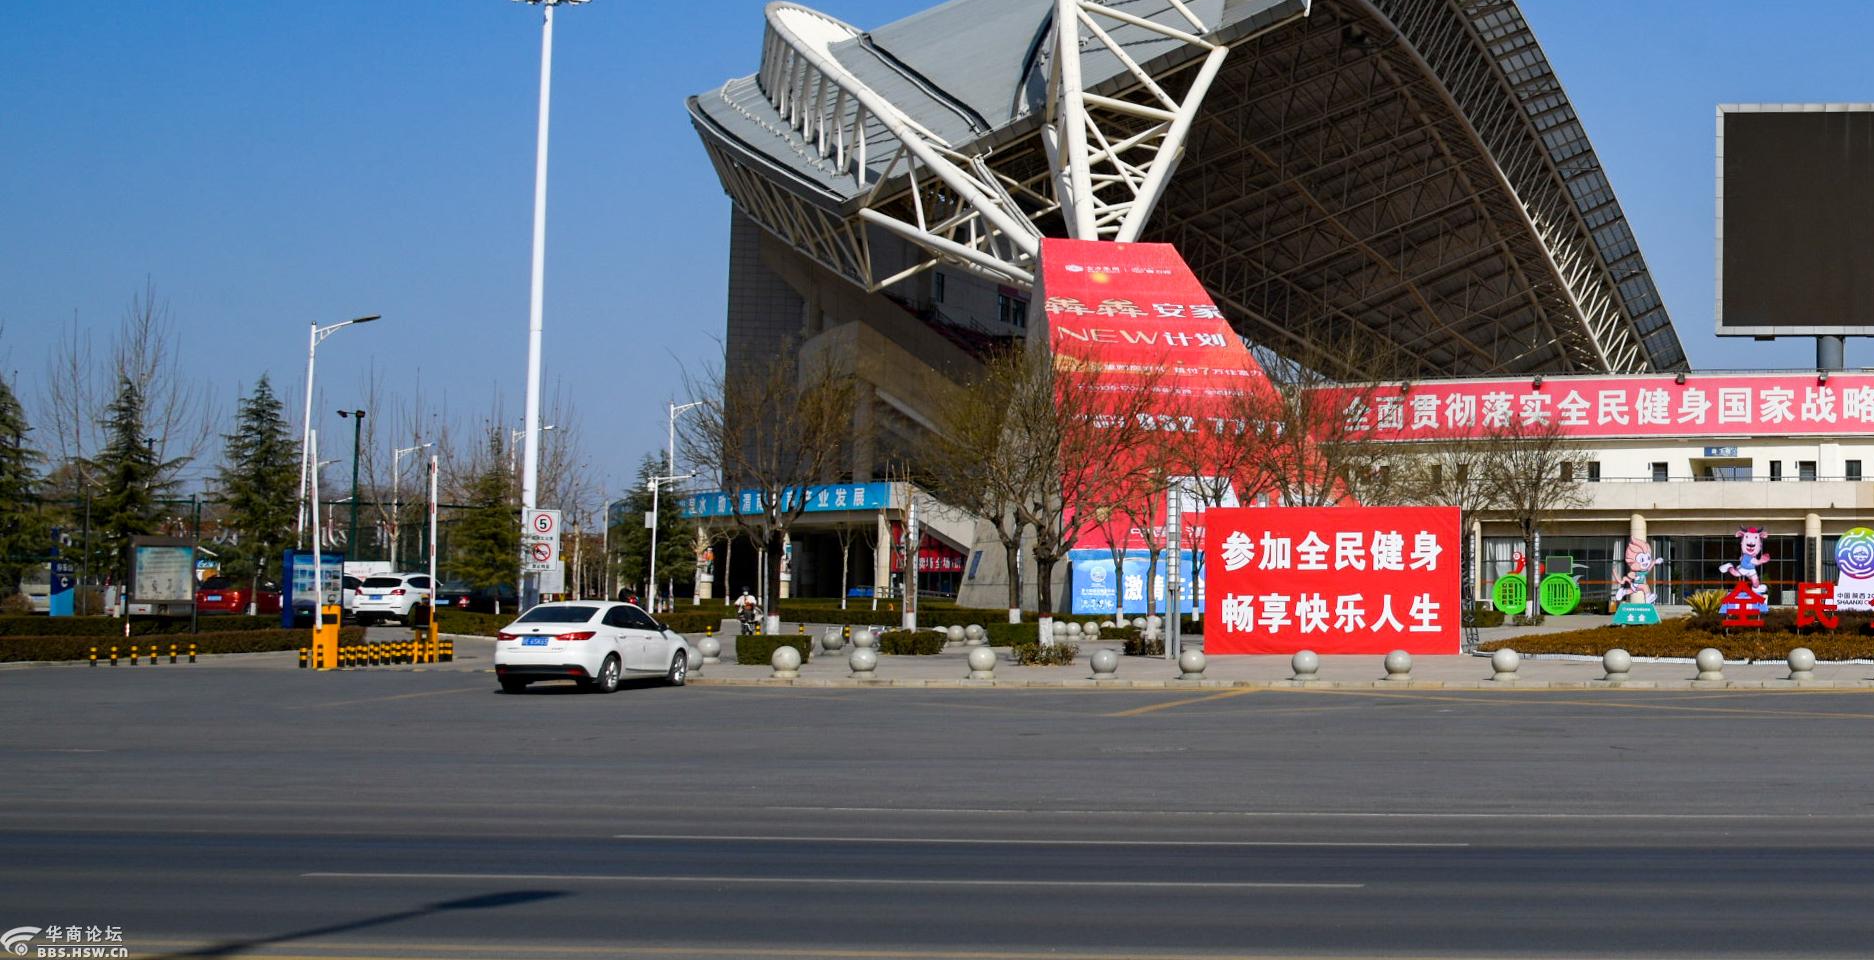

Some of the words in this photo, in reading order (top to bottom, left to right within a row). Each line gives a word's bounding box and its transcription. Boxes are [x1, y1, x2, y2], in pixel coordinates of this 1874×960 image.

[539, 518, 547, 530] 5
[1221, 530, 1443, 572] 参加全民健身
[1221, 593, 1443, 633] 畅享快乐人生
